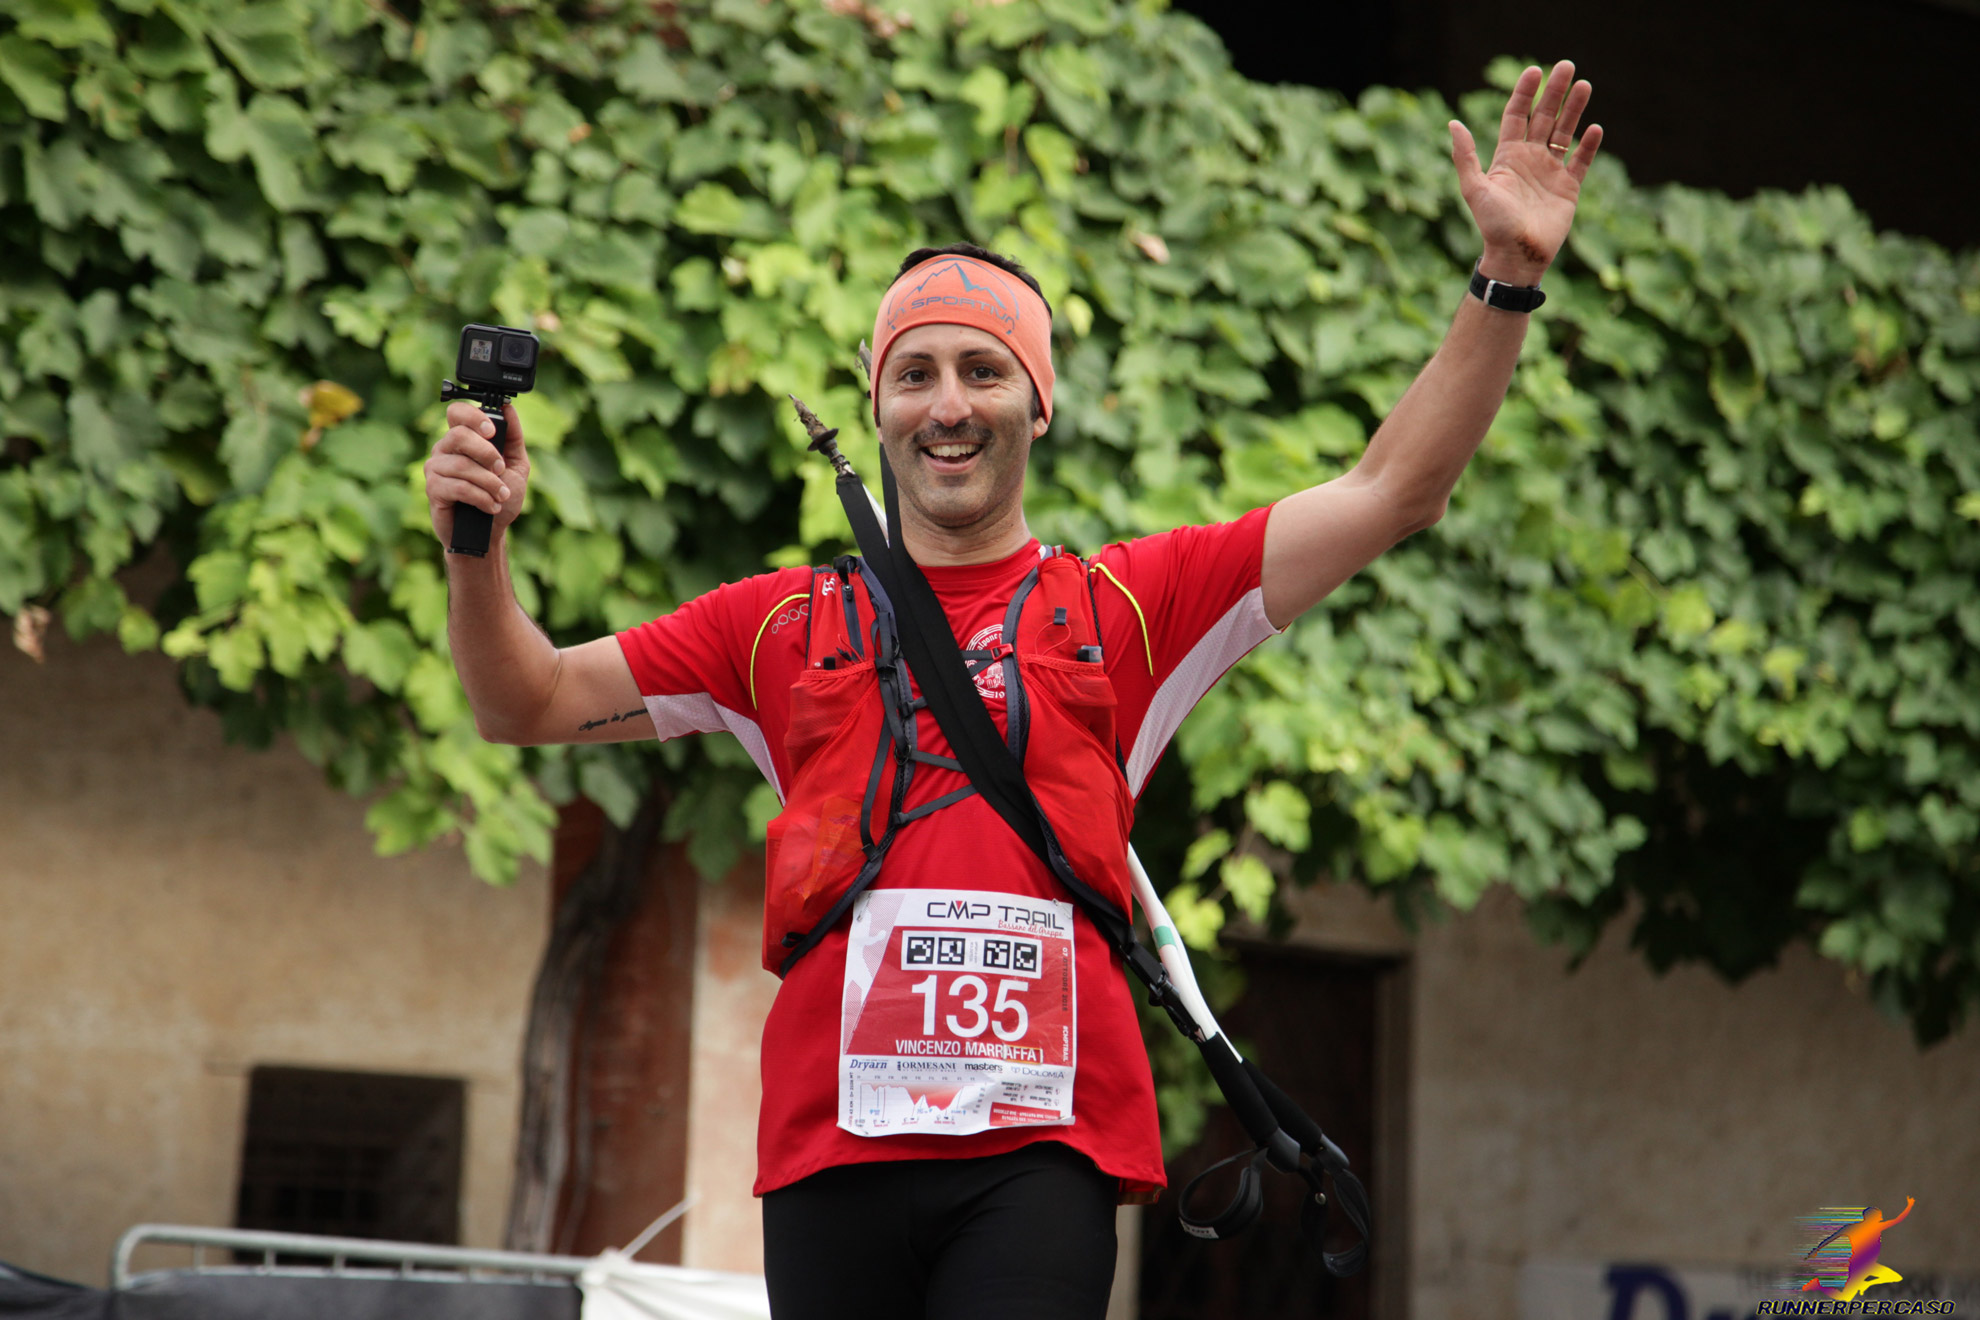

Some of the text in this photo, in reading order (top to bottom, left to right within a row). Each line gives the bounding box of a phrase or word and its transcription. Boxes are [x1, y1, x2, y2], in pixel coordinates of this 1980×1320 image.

[912, 296, 1016, 330] SPORTIVA
[927, 900, 1065, 930] CMP TRAIL
[998, 919, 1064, 939] Bassano del Grappa
[1062, 947, 1069, 957] 07
[911, 974, 1029, 1042] 135
[895, 1039, 1037, 1062] VINCENZO MARRAFFA
[849, 1059, 888, 1071] Dryarn
[902, 1061, 957, 1070] ORMESANI
[965, 1063, 1003, 1071] masters
